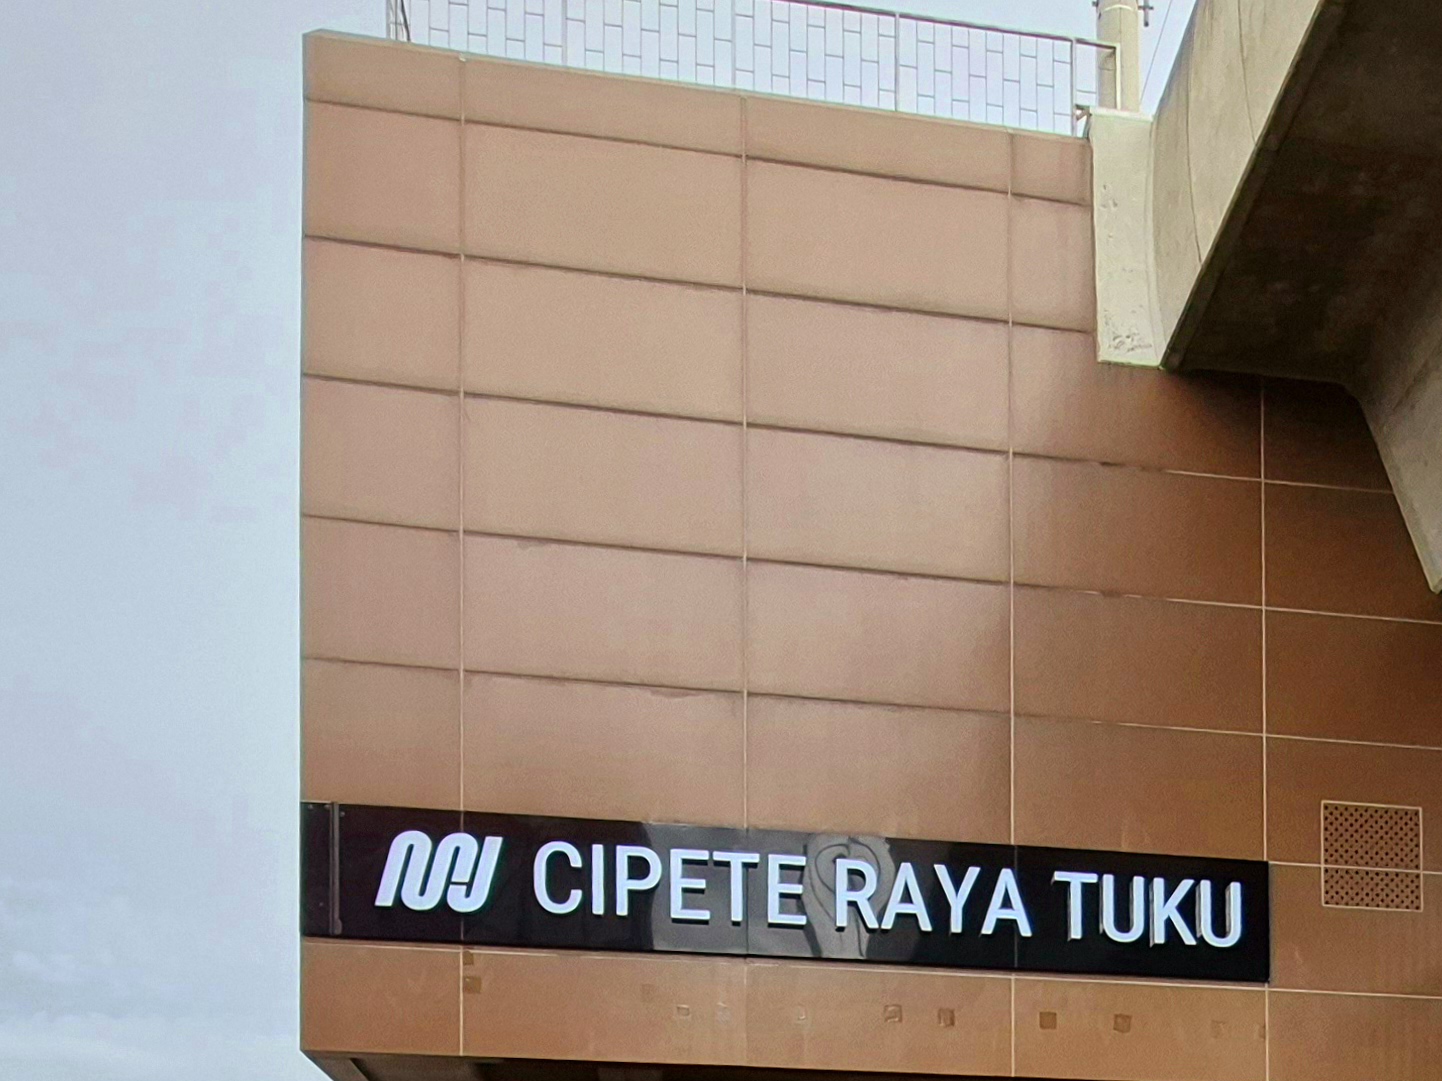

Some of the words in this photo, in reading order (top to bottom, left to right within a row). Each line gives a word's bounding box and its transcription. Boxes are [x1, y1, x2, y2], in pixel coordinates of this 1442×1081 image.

[533, 841, 807, 926] CIPETE
[834, 858, 1033, 938] RAYA
[1051, 870, 1243, 948] TUKU
